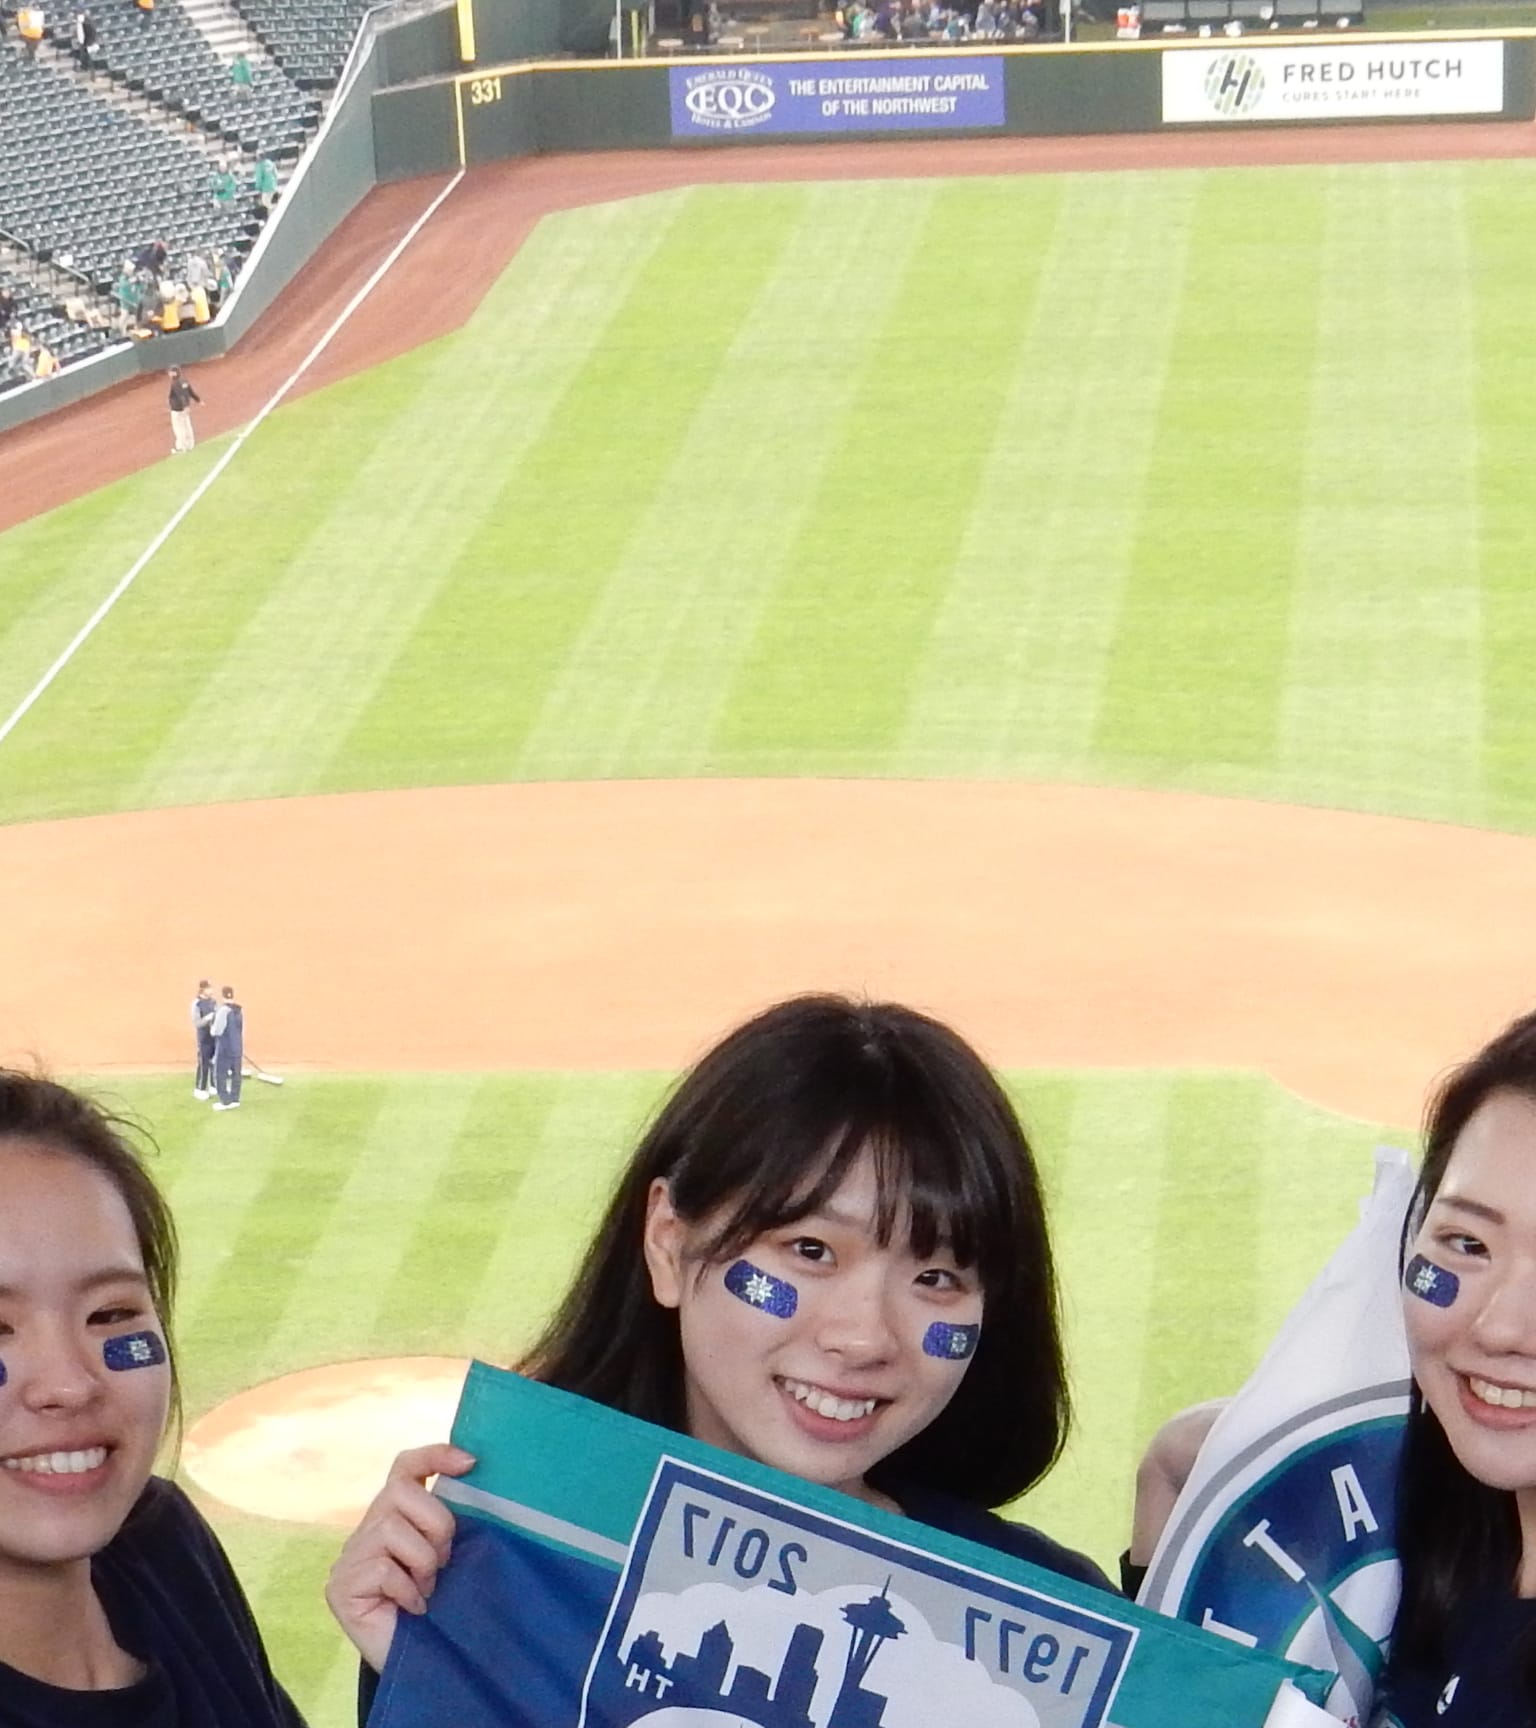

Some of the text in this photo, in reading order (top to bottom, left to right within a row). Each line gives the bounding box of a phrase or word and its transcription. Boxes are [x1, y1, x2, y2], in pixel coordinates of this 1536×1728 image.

[1282, 58, 1463, 84] FRED HUTCH
[471, 77, 502, 104] 331
[789, 73, 990, 96] THE ENTERTAINMENT CAPITAL
[698, 85, 771, 119] EQC
[822, 96, 958, 117] OF THE NORTHWEST
